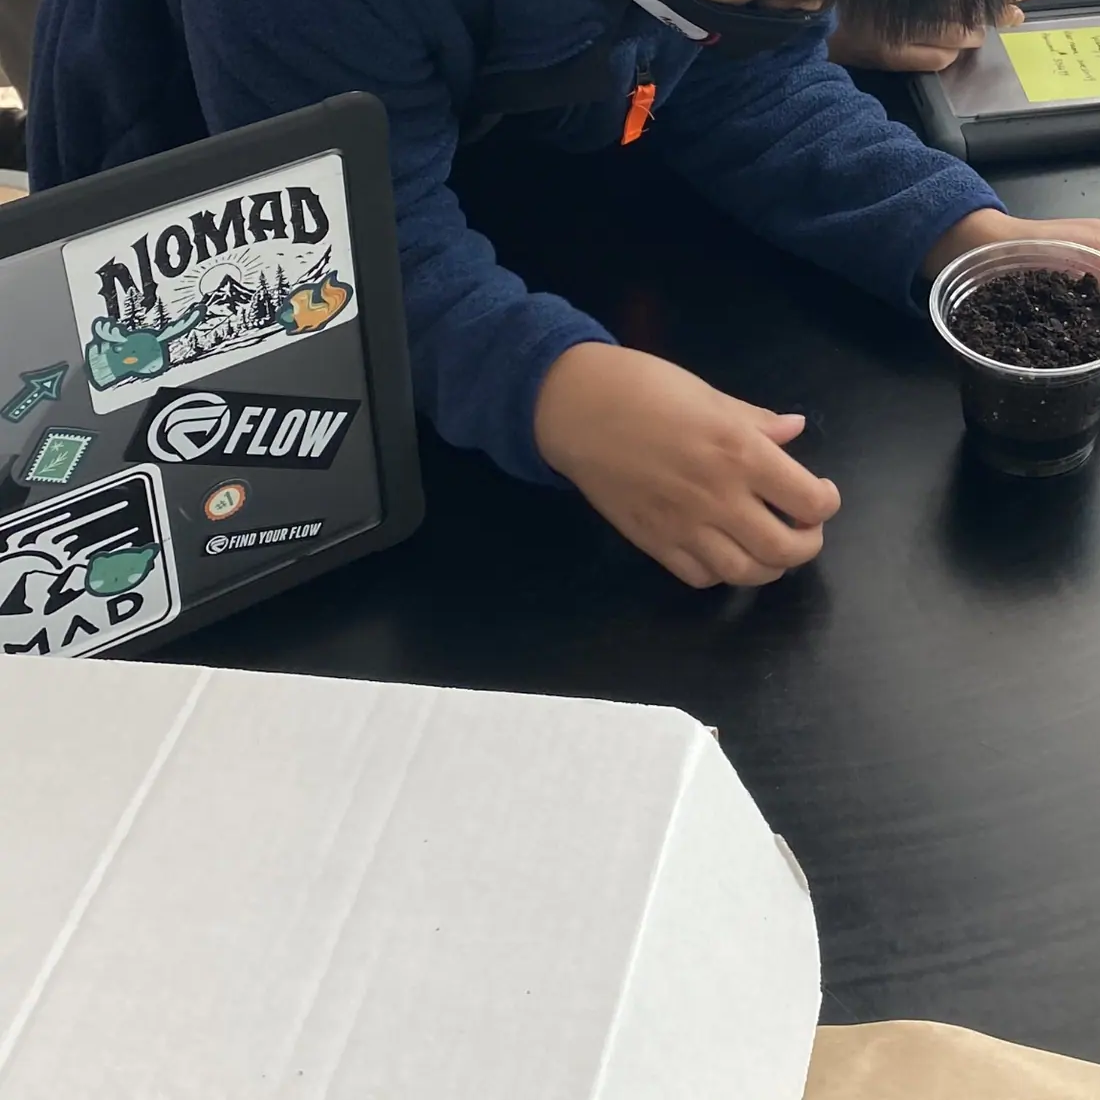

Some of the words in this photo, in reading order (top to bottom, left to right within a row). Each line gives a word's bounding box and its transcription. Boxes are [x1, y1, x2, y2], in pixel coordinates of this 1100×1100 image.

[96, 187, 330, 318] NOMAD
[223, 406, 348, 458] FLOW
[228, 531, 258, 549] FIND
[259, 527, 288, 545] YOUR
[288, 522, 322, 540] FLOW
